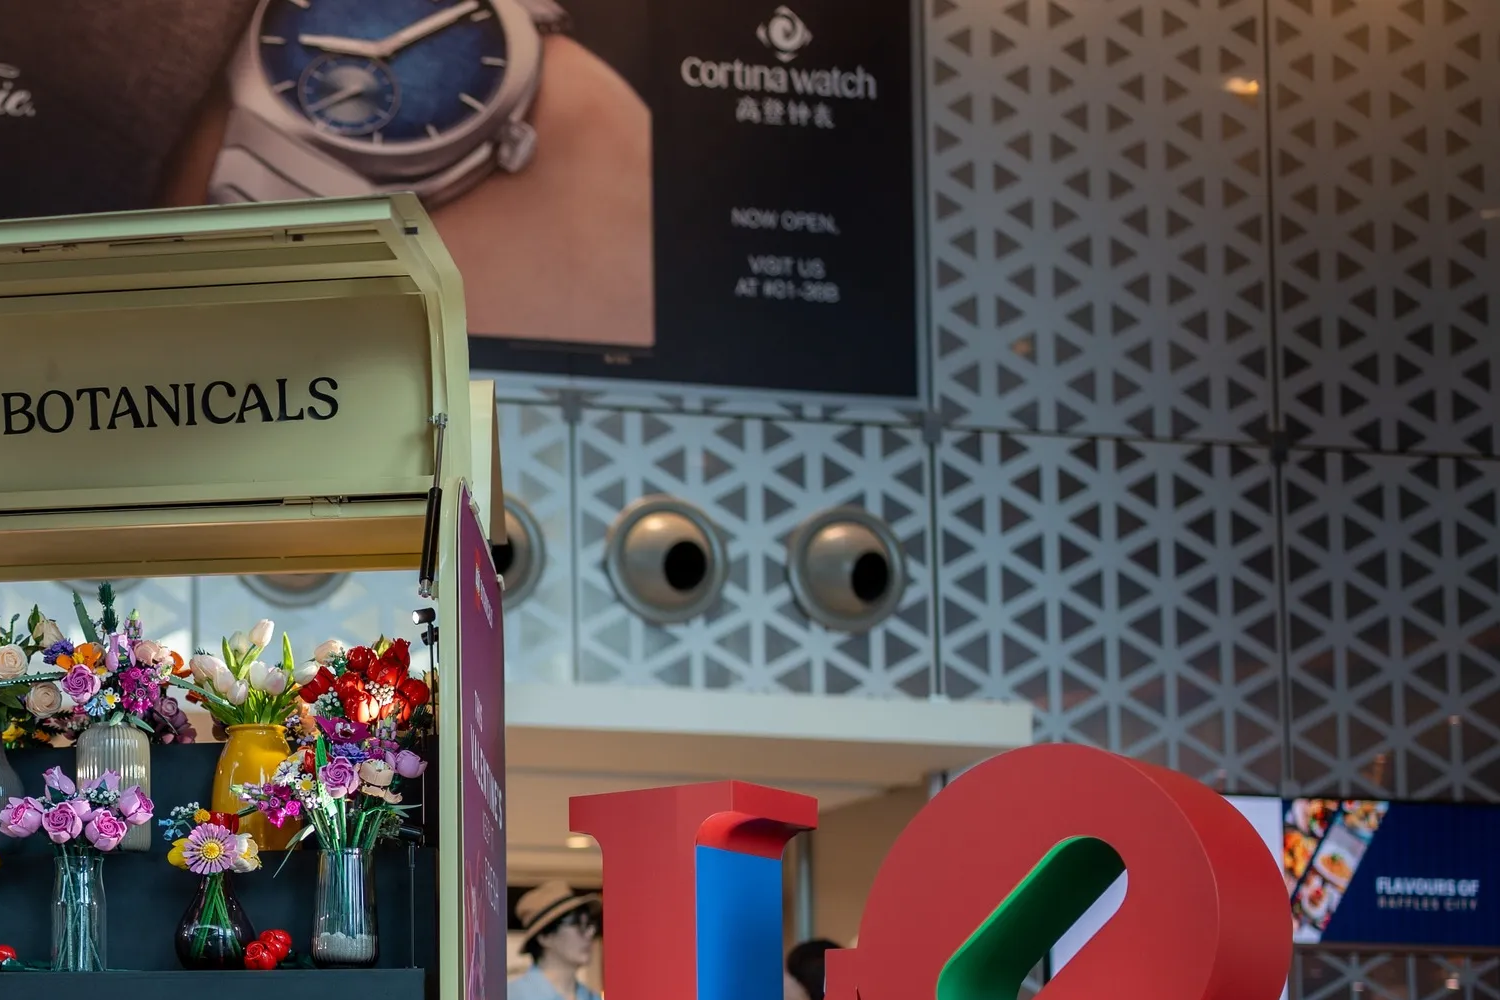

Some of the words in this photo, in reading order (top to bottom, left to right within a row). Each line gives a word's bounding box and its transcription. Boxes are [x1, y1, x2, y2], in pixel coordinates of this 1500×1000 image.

[681, 56, 788, 93] Cortina
[789, 64, 878, 100] watch
[731, 206, 779, 230] NOW
[734, 276, 759, 298] AT
[1, 376, 339, 435] BOTANICALS
[1376, 876, 1456, 896] FLAVOURS
[1457, 879, 1479, 897] OF
